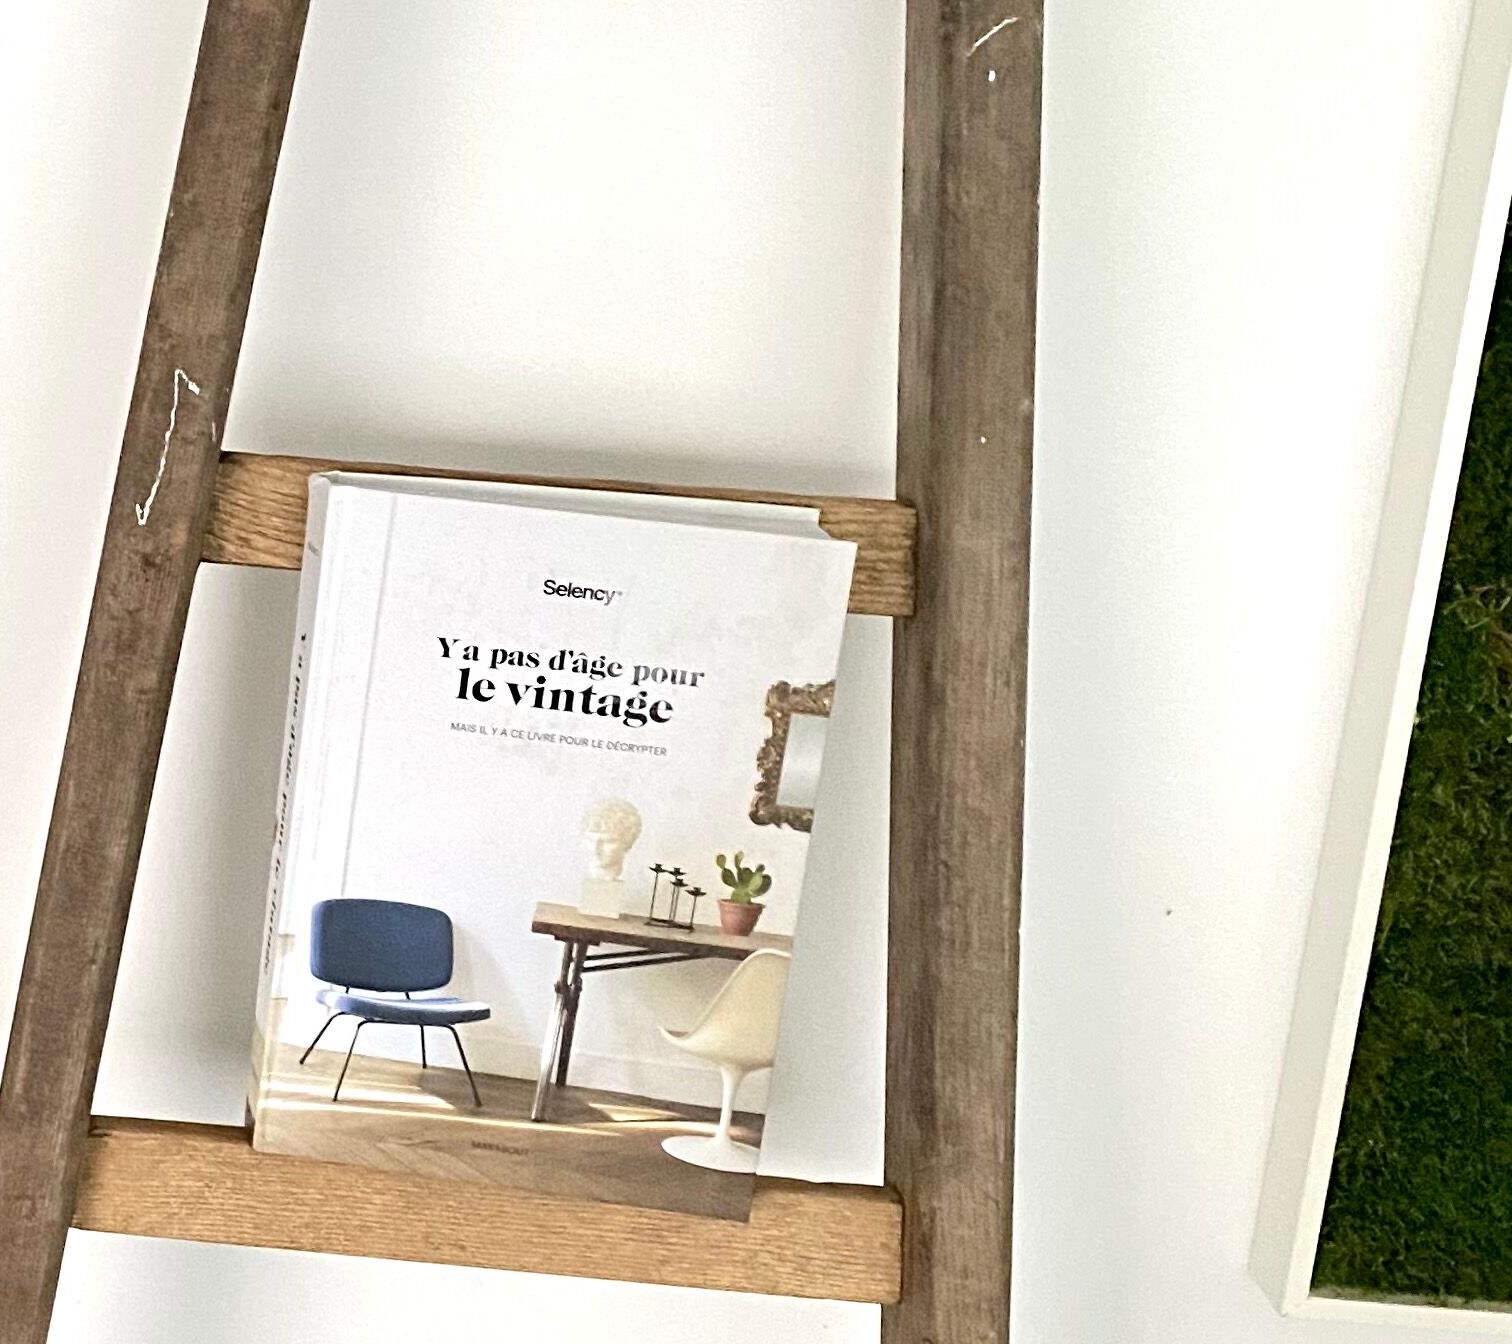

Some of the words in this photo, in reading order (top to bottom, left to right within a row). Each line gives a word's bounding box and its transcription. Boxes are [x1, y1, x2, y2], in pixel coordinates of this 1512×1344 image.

[543, 579, 616, 606] Selency
[462, 644, 480, 662] a
[488, 648, 540, 669] pas
[548, 649, 624, 681] d'âge
[631, 663, 706, 688] pour
[455, 667, 496, 703] le
[504, 675, 674, 729] vintage
[450, 722, 477, 734] MAIS
[491, 726, 499, 736] Y
[500, 727, 509, 737] A
[511, 728, 525, 740] CE
[527, 730, 557, 744] LIVRE
[559, 734, 589, 748] POUR
[591, 738, 604, 750] LE
